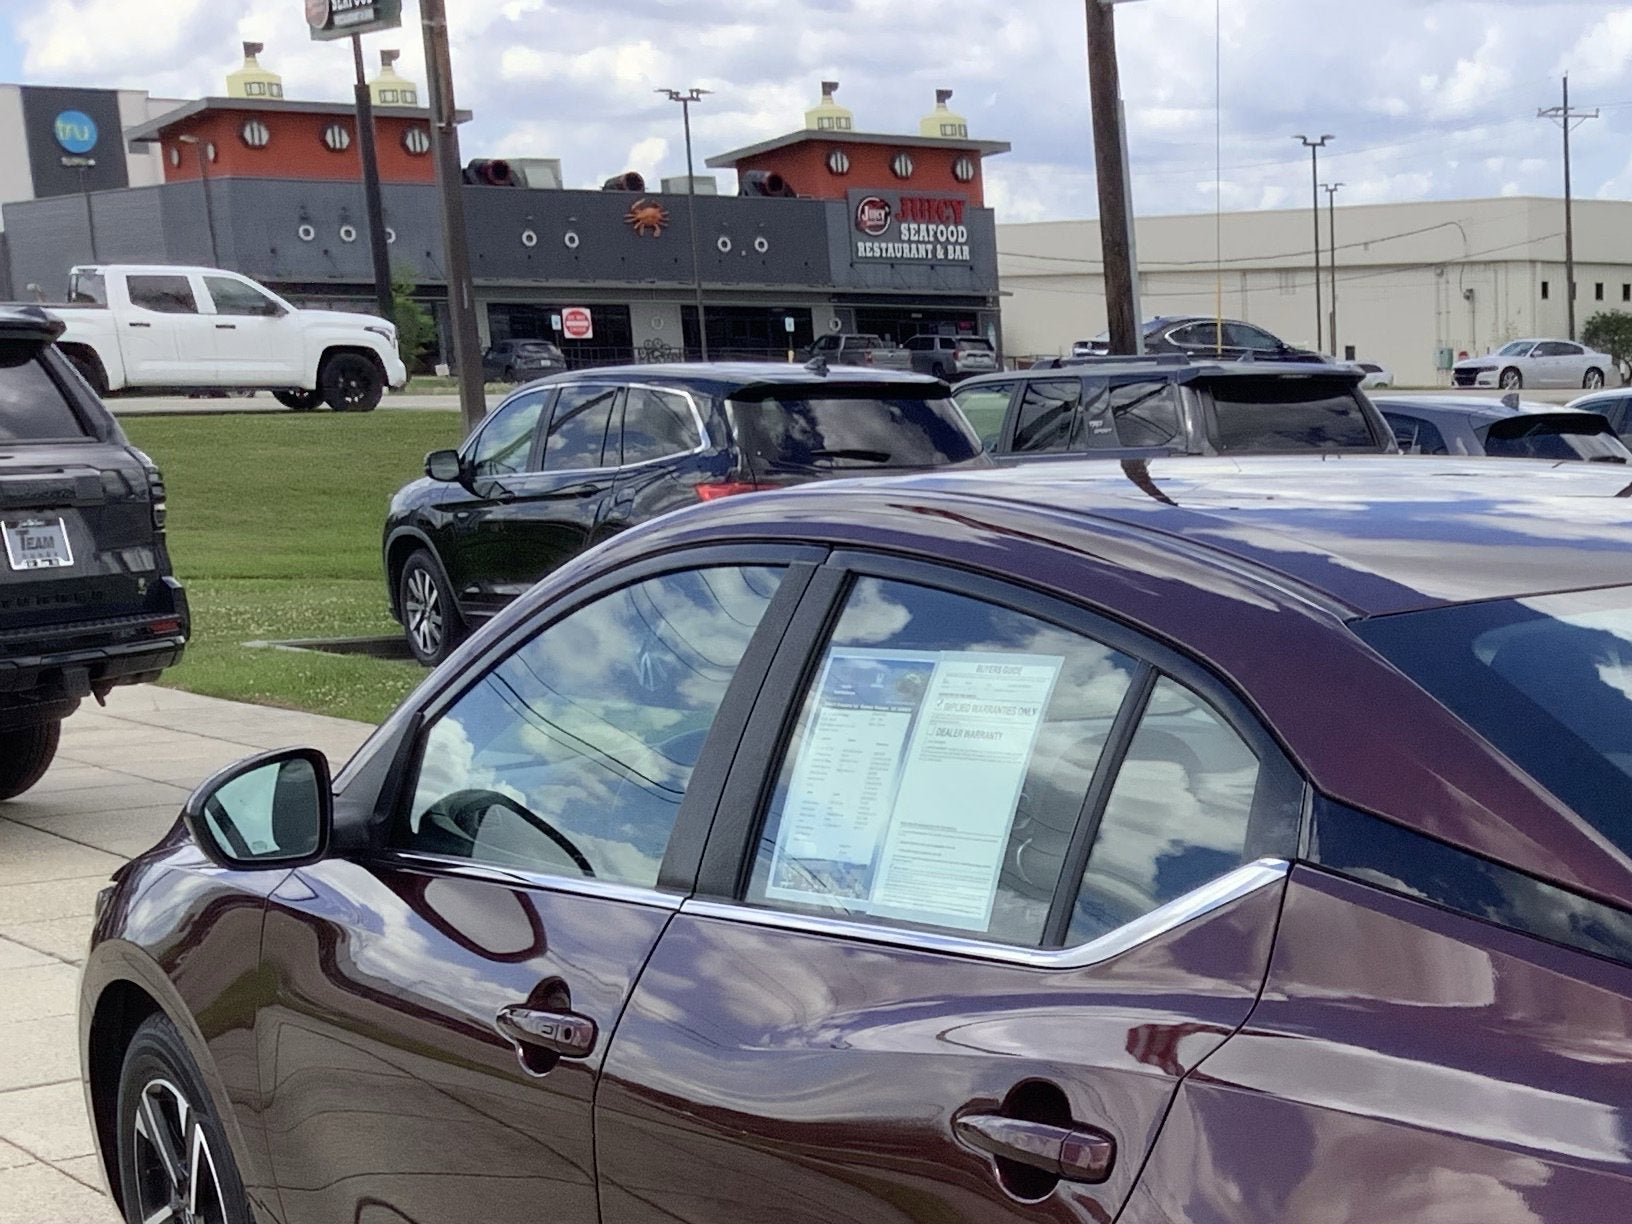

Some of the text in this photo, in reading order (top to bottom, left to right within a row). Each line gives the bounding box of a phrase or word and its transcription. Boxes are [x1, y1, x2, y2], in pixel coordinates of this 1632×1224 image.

[56, 119, 90, 141] tru
[896, 197, 965, 224] JUICY
[900, 223, 968, 242] SEAFOOD
[857, 241, 970, 260] RESTAURANT & BAR
[16, 529, 55, 551] TEAM
[1018, 706, 1038, 717] ONLY
[936, 727, 1004, 740] DEALER WARRANTY
